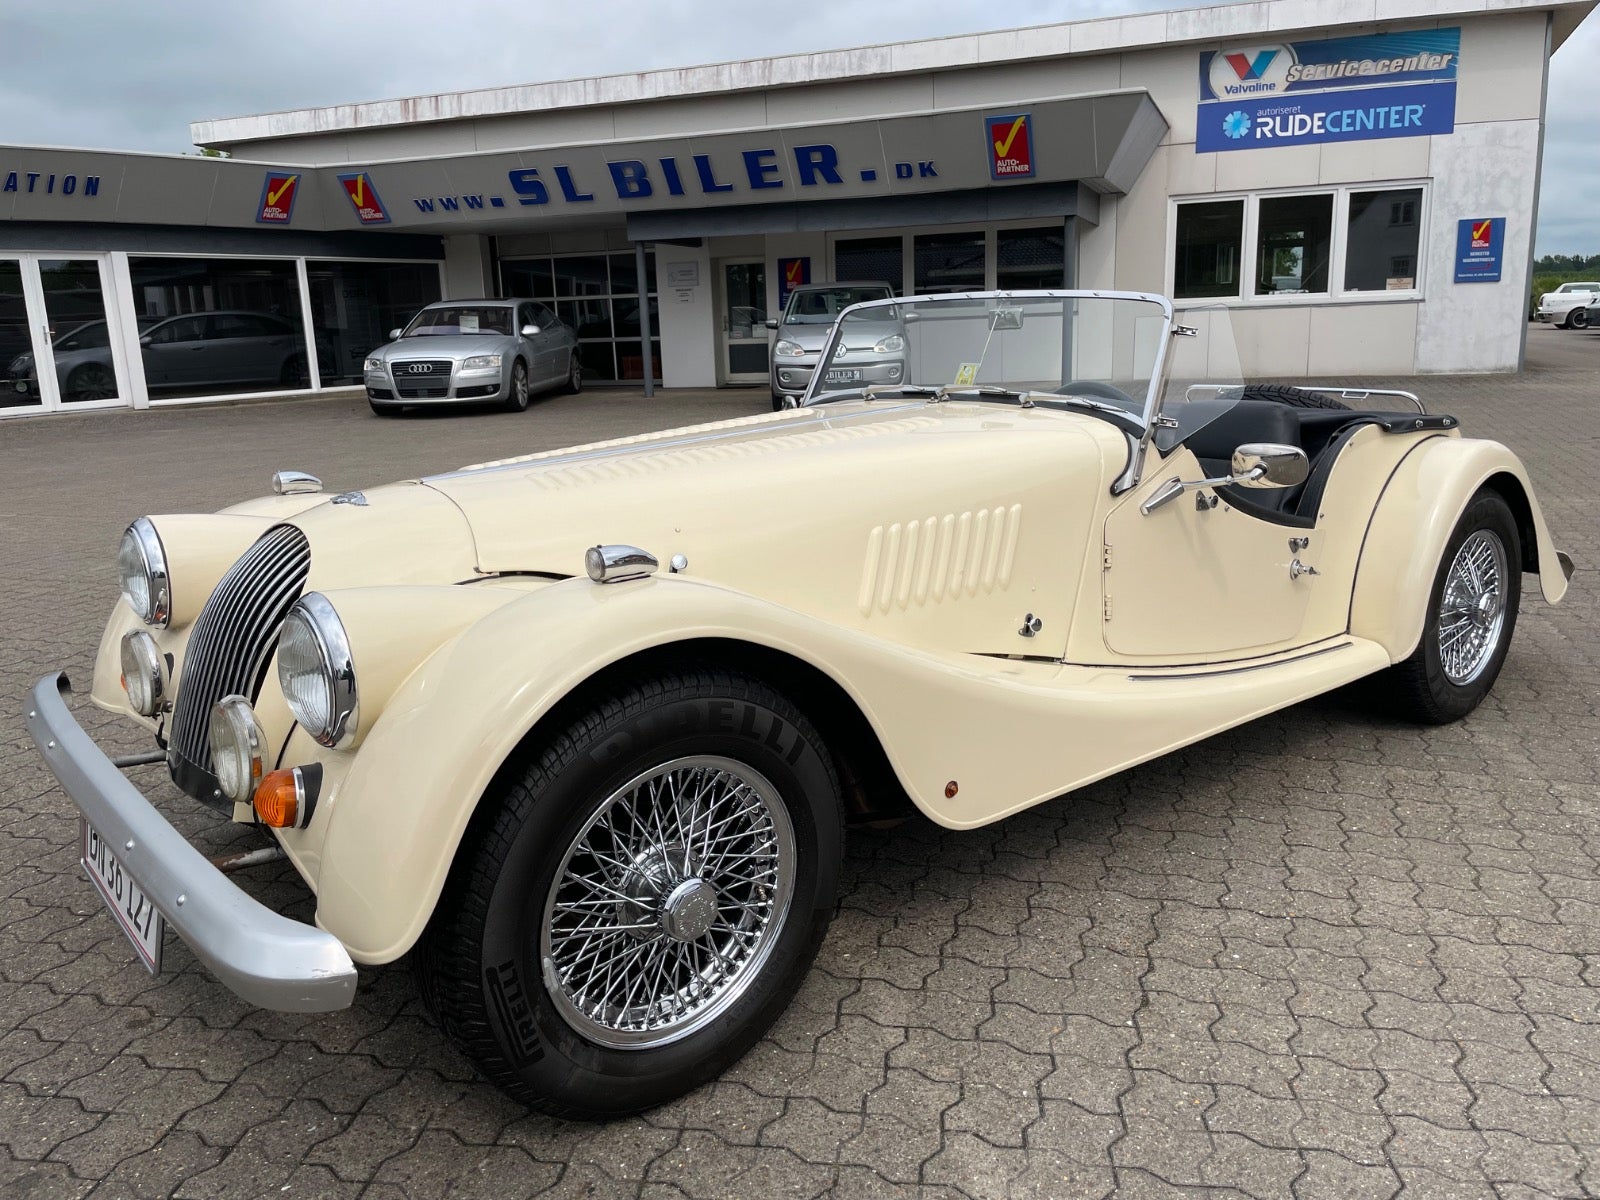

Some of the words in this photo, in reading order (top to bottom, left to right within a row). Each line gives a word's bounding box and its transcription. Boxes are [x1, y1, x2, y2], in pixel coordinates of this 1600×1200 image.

[1286, 60, 1372, 83] Service
[1376, 51, 1453, 75] center
[1225, 82, 1276, 95] Valvoline
[1257, 105, 1302, 117] autoriseret
[3, 171, 100, 196] ATION
